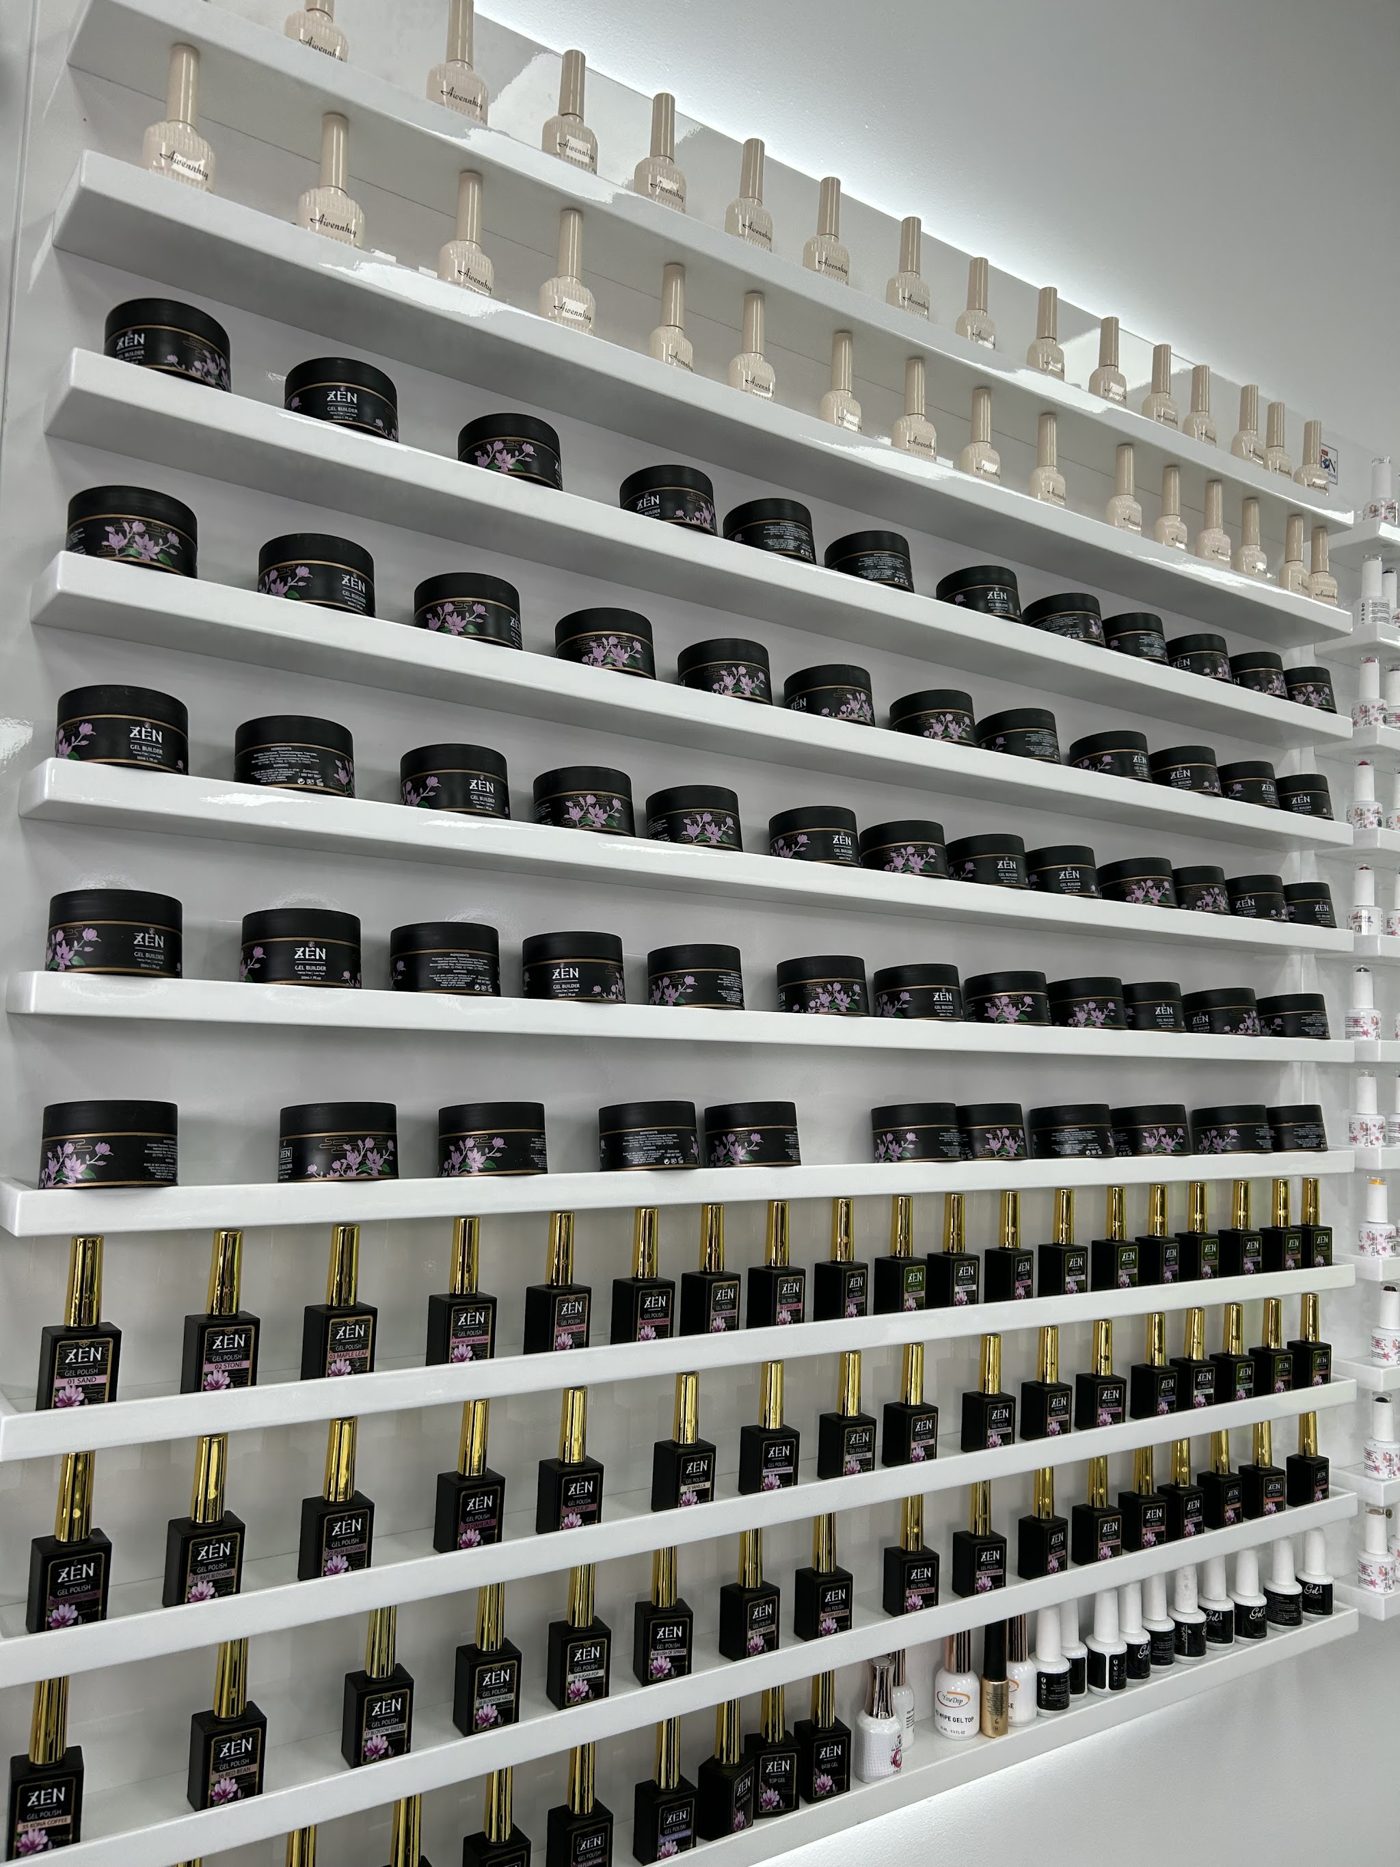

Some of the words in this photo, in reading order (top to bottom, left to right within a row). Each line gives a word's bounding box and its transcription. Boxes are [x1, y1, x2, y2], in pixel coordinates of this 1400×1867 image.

[116, 333, 145, 350] ZEN
[326, 390, 358, 404] ZEN
[636, 494, 660, 510] ZEN
[341, 573, 366, 593] ZEN
[987, 590, 1007, 600] ZEN
[1172, 658, 1191, 669] ZEN
[130, 726, 162, 743] ZEN
[142, 746, 163, 755] BUILDER
[1133, 755, 1148, 765] ZEN
[1170, 769, 1191, 779] ZEN
[469, 778, 494, 793] ZEN
[1262, 784, 1275, 793] ZEN
[1291, 795, 1311, 805] ZEN
[832, 834, 852, 846] ZEN
[996, 860, 1017, 870] ZEN
[1058, 870, 1080, 880] ZEN
[1235, 898, 1256, 909] ZEN
[1314, 904, 1329, 912] ZEN
[133, 932, 164, 948] ZEN
[294, 947, 326, 960] ZEN
[552, 967, 579, 979] ZEN
[933, 991, 953, 1001] ZEN
[1155, 1006, 1173, 1015] ZEN
[1191, 1014, 1209, 1024] ZEN
[1017, 1262, 1030, 1272] ZEN
[1068, 1257, 1083, 1268] ZEN
[908, 1272, 922, 1283] ZEN
[958, 1266, 974, 1277] ZEN
[781, 1282, 799, 1294] ZEN
[849, 1276, 863, 1288] ZEN
[716, 1288, 734, 1300] ZEN
[644, 1295, 666, 1308] ZEN
[561, 1301, 583, 1315] ZEN
[458, 1311, 485, 1326] ZEN
[336, 1324, 365, 1340] ZEN
[212, 1333, 245, 1350] ZEN
[65, 1347, 102, 1363] ZEN
[222, 1353, 243, 1361] POLISH
[337, 1351, 353, 1359] MAPLE
[223, 1361, 243, 1369] STONE
[64, 1369, 76, 1377] GEL
[77, 1367, 98, 1376] POLISH
[1197, 1371, 1212, 1383] ZEN
[77, 1376, 96, 1384] SAND
[1160, 1377, 1174, 1390] ZEN
[1102, 1389, 1119, 1401] ZEN
[1051, 1396, 1067, 1408] ZEN
[991, 1408, 1009, 1420] ZEN
[915, 1419, 933, 1431] ZEN
[849, 1432, 869, 1445] ZEN
[768, 1445, 790, 1458] ZEN
[686, 1460, 708, 1474] ZEN
[568, 1480, 593, 1495] ZEN
[466, 1495, 492, 1511] ZEN
[1186, 1499, 1200, 1511] ZEN
[1146, 1508, 1162, 1520] ZEN
[332, 1518, 361, 1535] ZEN
[1102, 1521, 1118, 1533] ZEN
[331, 1540, 341, 1548] GEL
[342, 1537, 360, 1546] POLISH
[1051, 1532, 1064, 1544] ZEN
[197, 1541, 231, 1560] ZEN
[981, 1550, 1000, 1562] ZEN
[57, 1562, 95, 1583] ZEN
[196, 1565, 207, 1573] GEL
[208, 1562, 227, 1571] POLISH
[911, 1567, 931, 1580] ZEN
[57, 1588, 68, 1596] GEL
[70, 1583, 91, 1593] POLISH
[825, 1588, 845, 1602] ZEN
[752, 1603, 773, 1619] ZEN
[656, 1625, 682, 1639] ZEN
[574, 1645, 600, 1661] ZEN
[483, 1669, 509, 1686] ZEN
[482, 1689, 491, 1697] GEL
[492, 1686, 508, 1695] POLISH
[372, 1697, 401, 1716] ZEN
[371, 1720, 381, 1728] GEL
[382, 1716, 399, 1725] POLISH
[953, 1716, 963, 1724] GEL
[220, 1737, 253, 1758] ZEN
[819, 1745, 841, 1759] ZEN
[219, 1763, 229, 1771] GEL
[231, 1758, 250, 1768] POLISH
[236, 1766, 251, 1775] BEAN
[765, 1760, 790, 1773] ZEN
[27, 1787, 65, 1807] ZEN
[26, 1812, 38, 1821] GEL
[40, 1808, 62, 1818] POLISH
[666, 1810, 687, 1823] ZEN
[47, 1817, 68, 1826] COFFEE
[580, 1836, 602, 1851] ZEN
